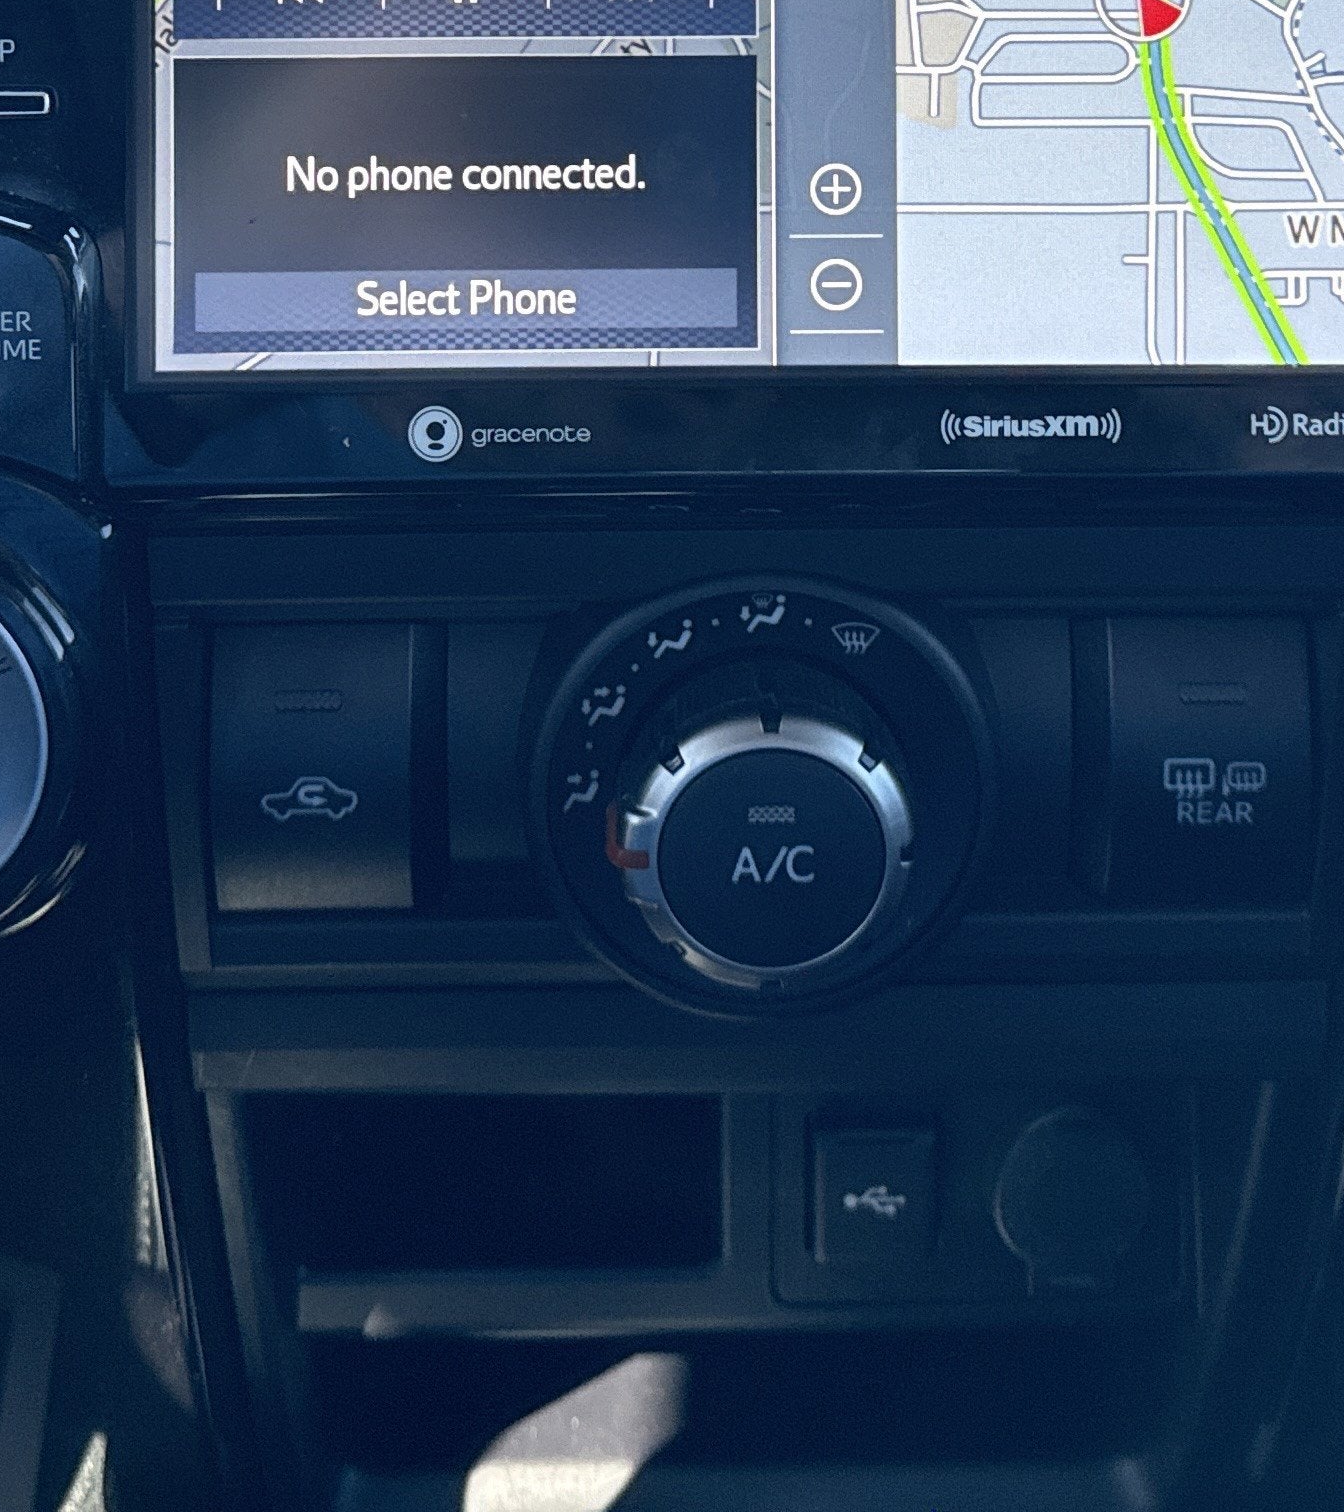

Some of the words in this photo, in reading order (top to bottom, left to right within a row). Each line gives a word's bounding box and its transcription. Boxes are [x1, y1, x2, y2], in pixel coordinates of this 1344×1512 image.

[285, 155, 340, 193] No
[347, 155, 453, 199] phone
[461, 153, 647, 191] connected.
[1286, 214, 1321, 244] W
[355, 279, 461, 318] Select
[468, 278, 578, 316] Phone
[471, 424, 592, 446] gracenote
[1176, 801, 1254, 825] REAR
[731, 844, 815, 885] A/C
